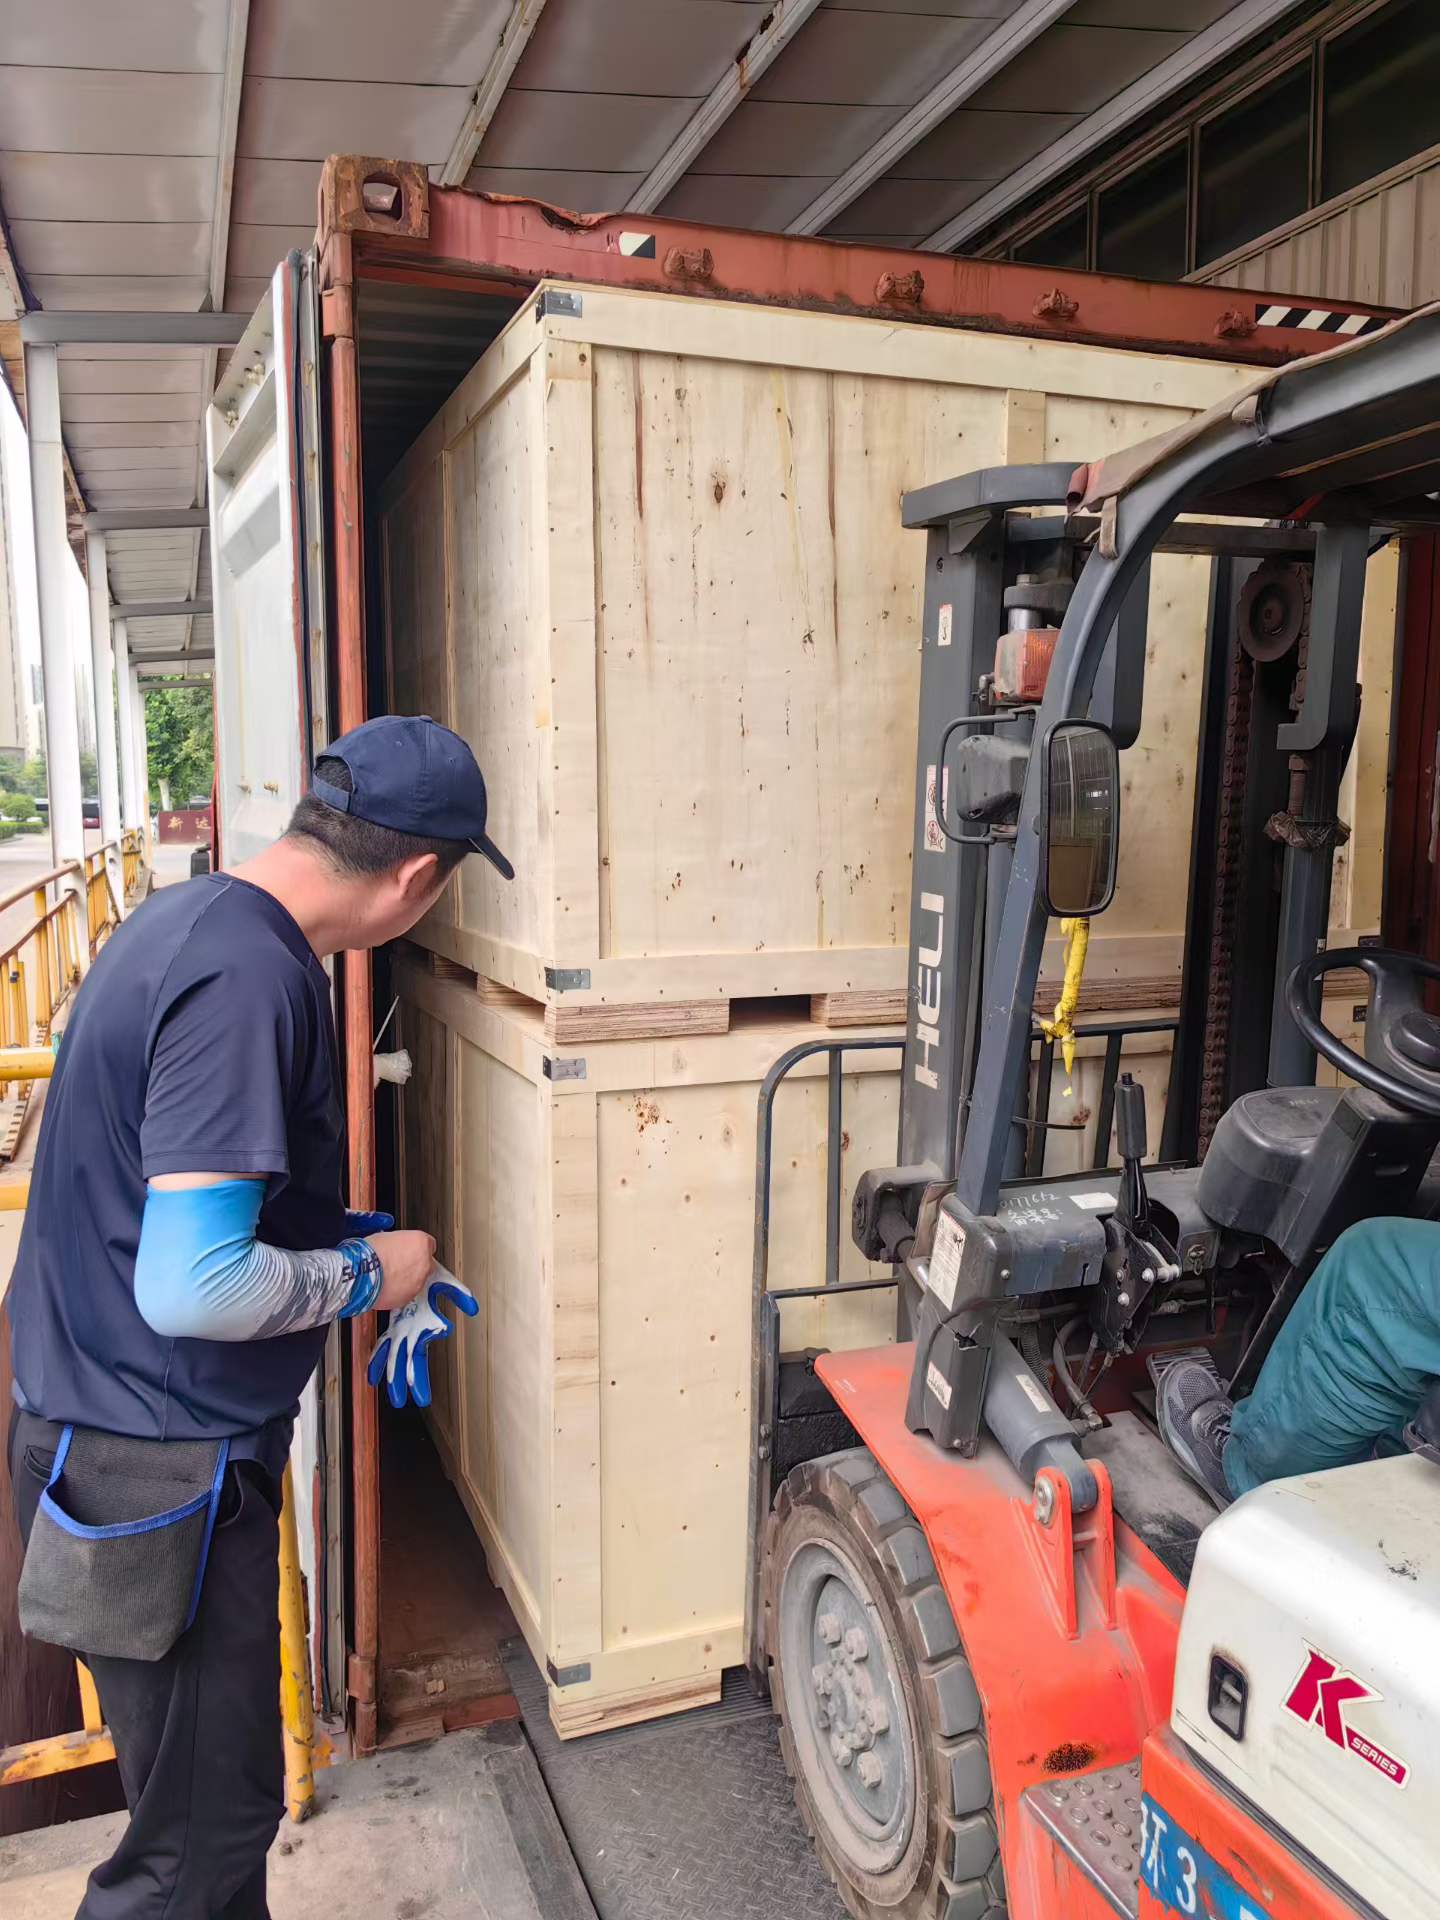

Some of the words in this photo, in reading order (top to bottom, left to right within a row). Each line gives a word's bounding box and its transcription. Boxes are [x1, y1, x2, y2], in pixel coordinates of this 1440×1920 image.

[915, 892, 944, 1089] HELI
[1284, 1647, 1375, 1751] K
[1351, 1737, 1399, 1776] SERIES
